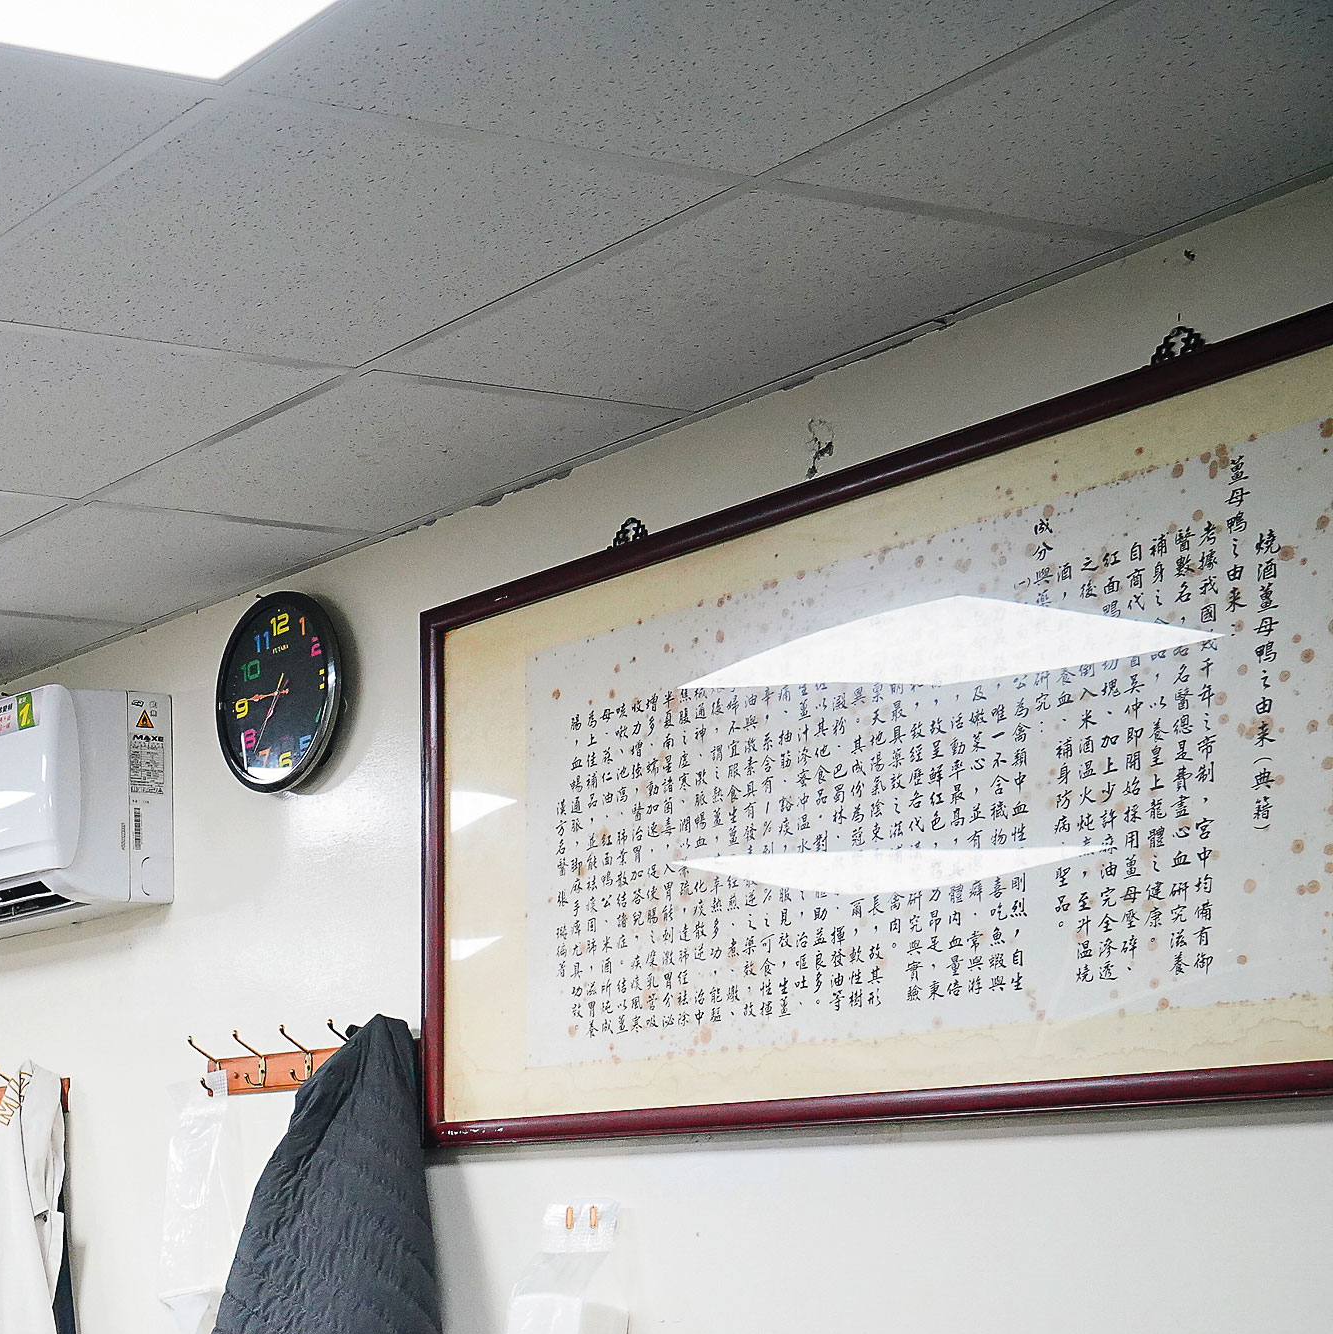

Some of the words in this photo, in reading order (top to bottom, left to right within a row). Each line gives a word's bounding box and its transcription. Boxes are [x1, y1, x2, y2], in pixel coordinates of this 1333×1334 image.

[270, 612, 290, 636] 12
[299, 617, 306, 636] 1
[254, 630, 270, 653] 11
[240, 659, 261, 681] 10
[235, 698, 249, 719] 9
[244, 729, 257, 749] 8
[259, 748, 271, 767] 7
